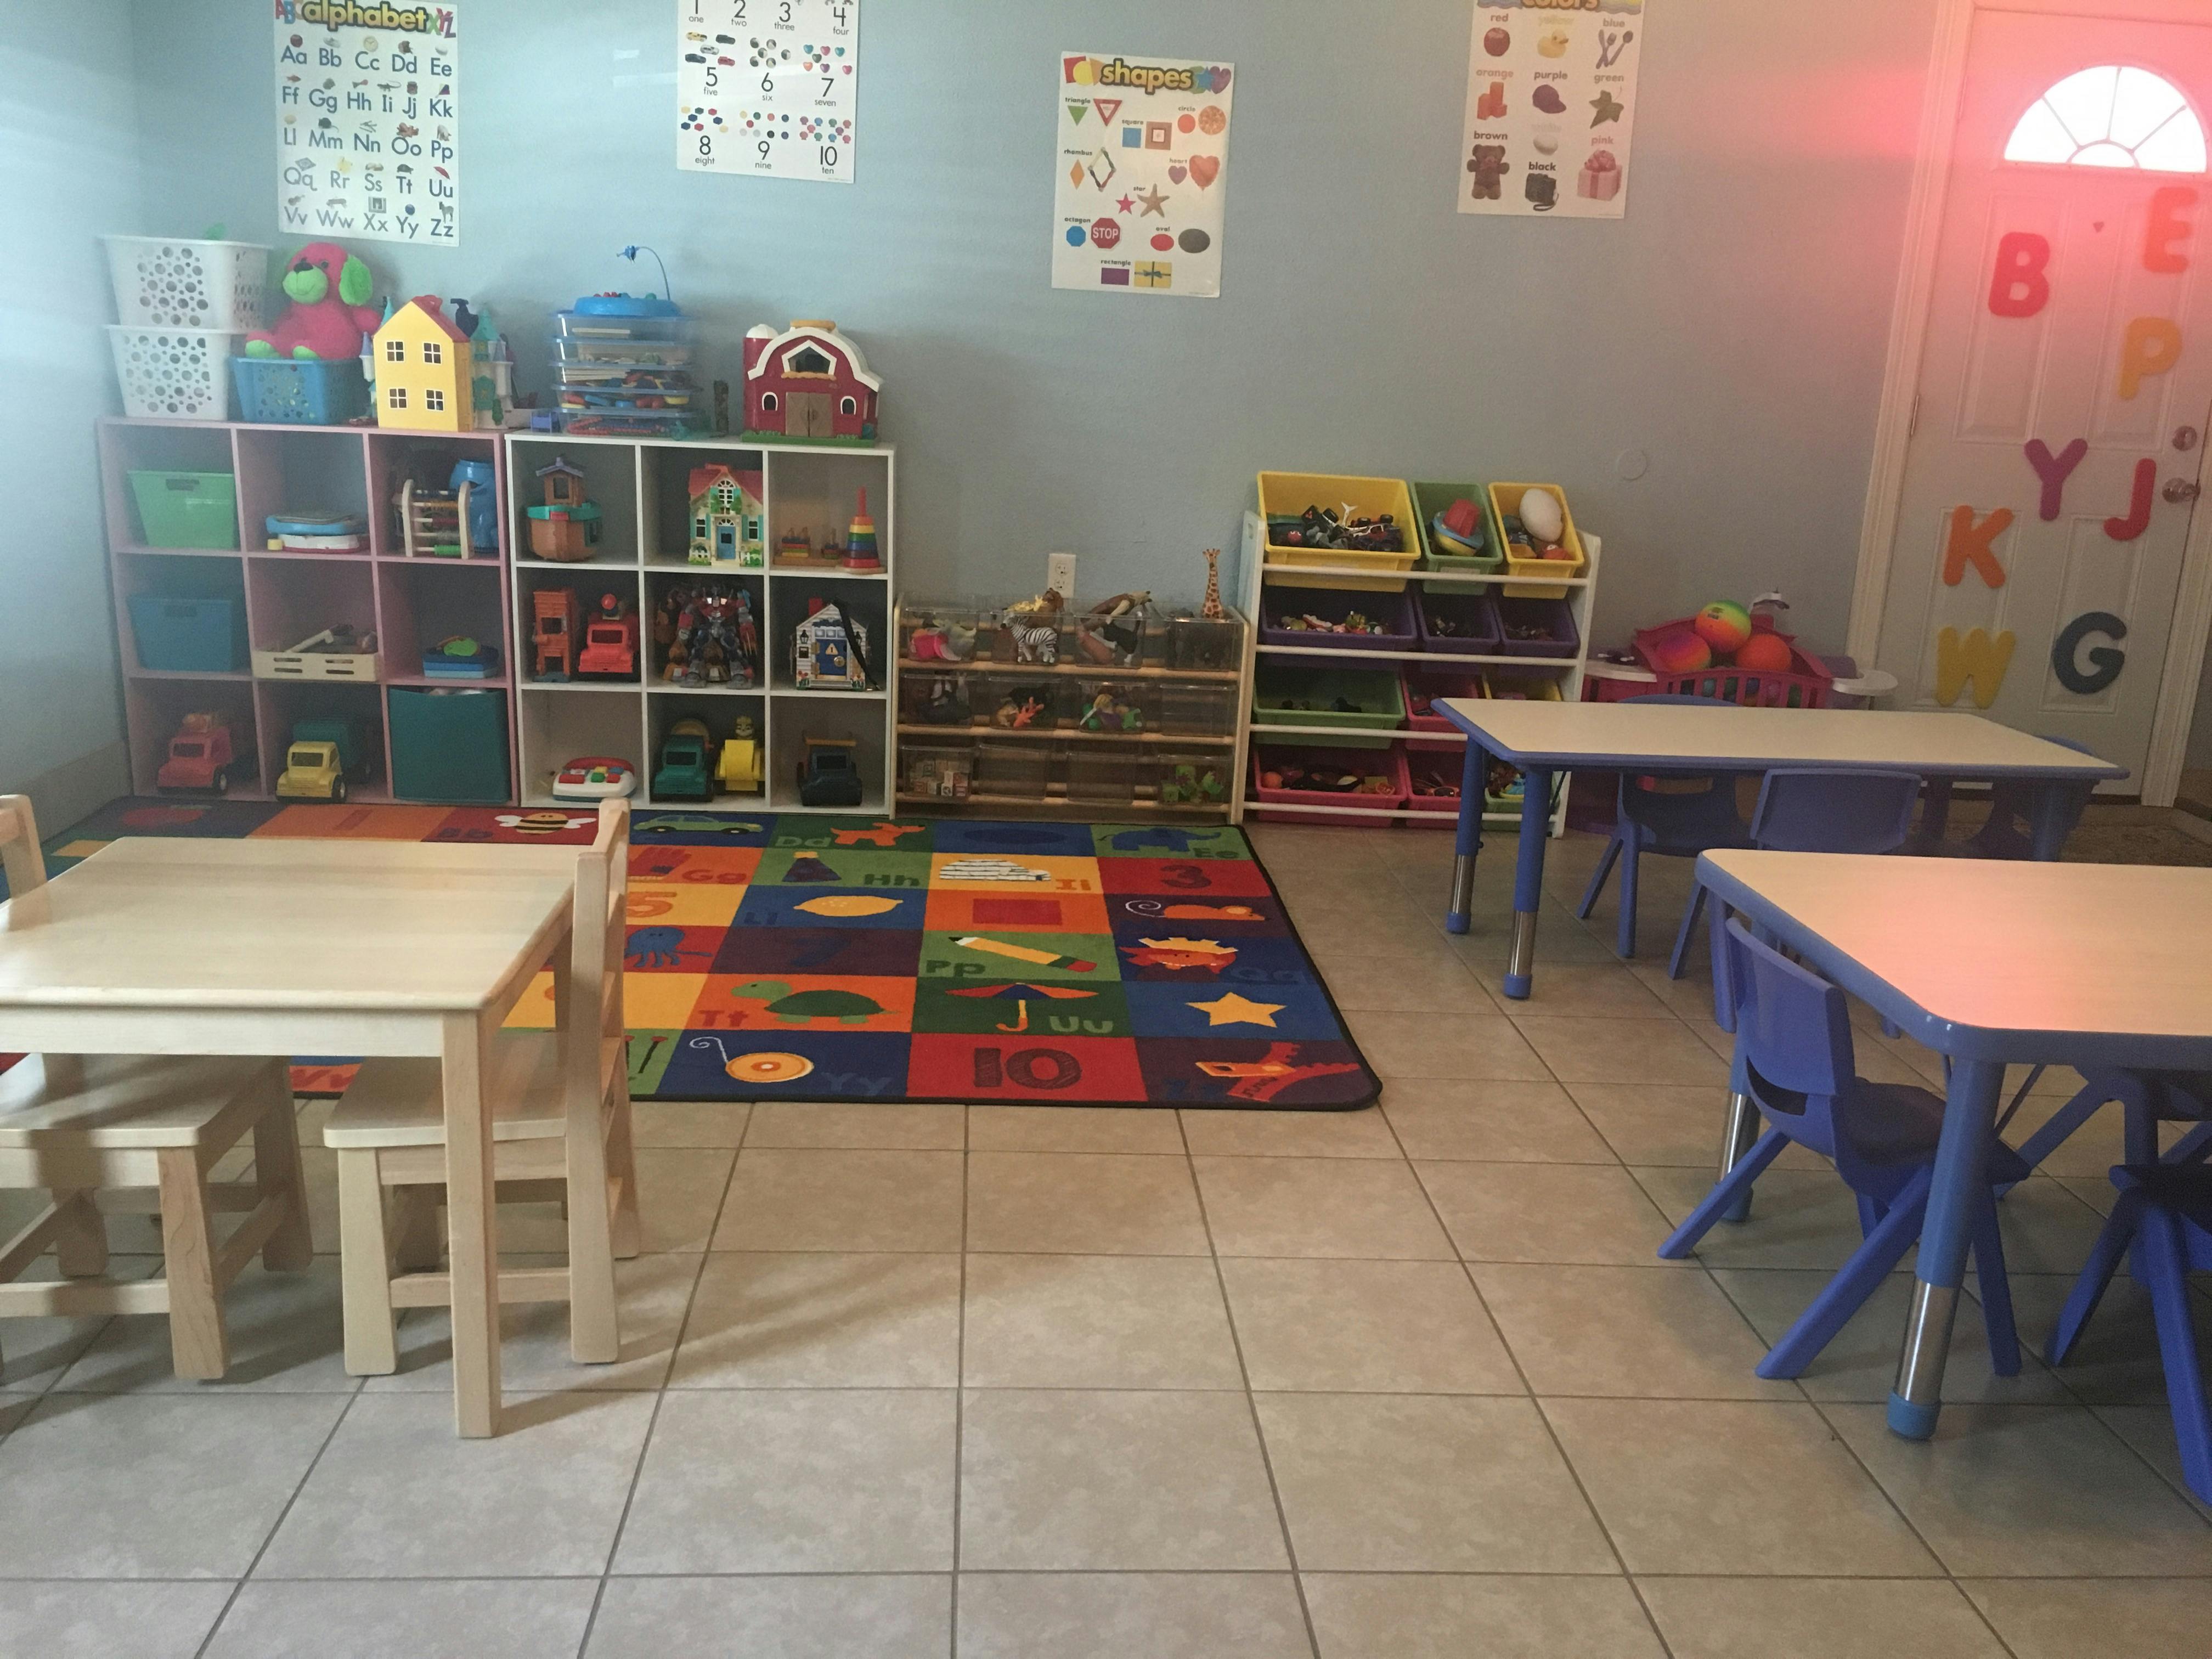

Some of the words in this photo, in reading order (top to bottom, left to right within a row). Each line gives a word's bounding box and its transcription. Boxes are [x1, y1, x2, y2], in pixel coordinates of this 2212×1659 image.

[302, 0, 428, 31] alphabet
[427, 7, 456, 38] XYZ
[693, 0, 699, 14] 1
[733, 0, 746, 19] 2
[779, 2, 791, 22] 3
[833, 7, 846, 27] 4
[731, 18, 747, 27] two
[774, 22, 795, 31] three
[833, 26, 849, 36] four
[1491, 13, 1509, 22] red
[1602, 18, 1626, 28] blue
[280, 45, 307, 65] Aa
[319, 48, 342, 67] Bb
[355, 51, 380, 71] Cc
[392, 54, 417, 74] Dd
[431, 57, 452, 77] Ee
[1476, 69, 1514, 80] orange
[706, 66, 718, 87] 5
[761, 72, 774, 92] 6
[821, 77, 834, 97] 7
[1101, 59, 1193, 94] shapes
[1533, 71, 1568, 81] purple
[1594, 74, 1624, 84] green
[282, 86, 300, 105] Ff
[308, 88, 337, 114] Gg
[347, 92, 371, 111] Hh
[382, 94, 393, 113] Ii
[402, 97, 417, 120] Jj
[430, 99, 453, 119] Kk
[703, 87, 718, 96] five
[814, 99, 836, 107] seven
[284, 127, 296, 146] Ll
[308, 129, 343, 150] Mm
[354, 133, 381, 153] Nn
[391, 137, 422, 156] Oo
[431, 140, 454, 163] Pp
[1473, 130, 1508, 140] brown
[1591, 135, 1614, 145] pink
[699, 135, 711, 155] 8
[758, 140, 770, 161] 9
[820, 145, 837, 166] 10
[695, 156, 715, 166] eight
[822, 166, 834, 175] ten
[1528, 161, 1556, 172] black
[284, 167, 318, 191] Qq
[330, 170, 351, 189] Rr
[364, 173, 382, 192] Ss
[396, 176, 413, 195] Tt
[429, 179, 453, 198] Uu
[284, 206, 308, 225] Vv
[316, 208, 355, 229] Ww
[363, 213, 389, 233] Xx
[396, 216, 419, 239] Yy
[431, 218, 454, 238] Zz
[1092, 227, 1119, 240] STOP
[2143, 187, 2198, 274] E
[1988, 231, 2051, 318] B
[2118, 315, 2183, 401] P
[2024, 438, 2088, 522] Y
[2103, 458, 2158, 541] J
[1942, 504, 2015, 589] K
[1935, 626, 2017, 709] W
[2052, 611, 2127, 695] G
[774, 836, 832, 847] Dd
[1159, 864, 1212, 889] 3
[625, 891, 678, 918] 5
[926, 960, 986, 977] Pp
[698, 1011, 748, 1027] Tt
[974, 1047, 1082, 1090] 10
